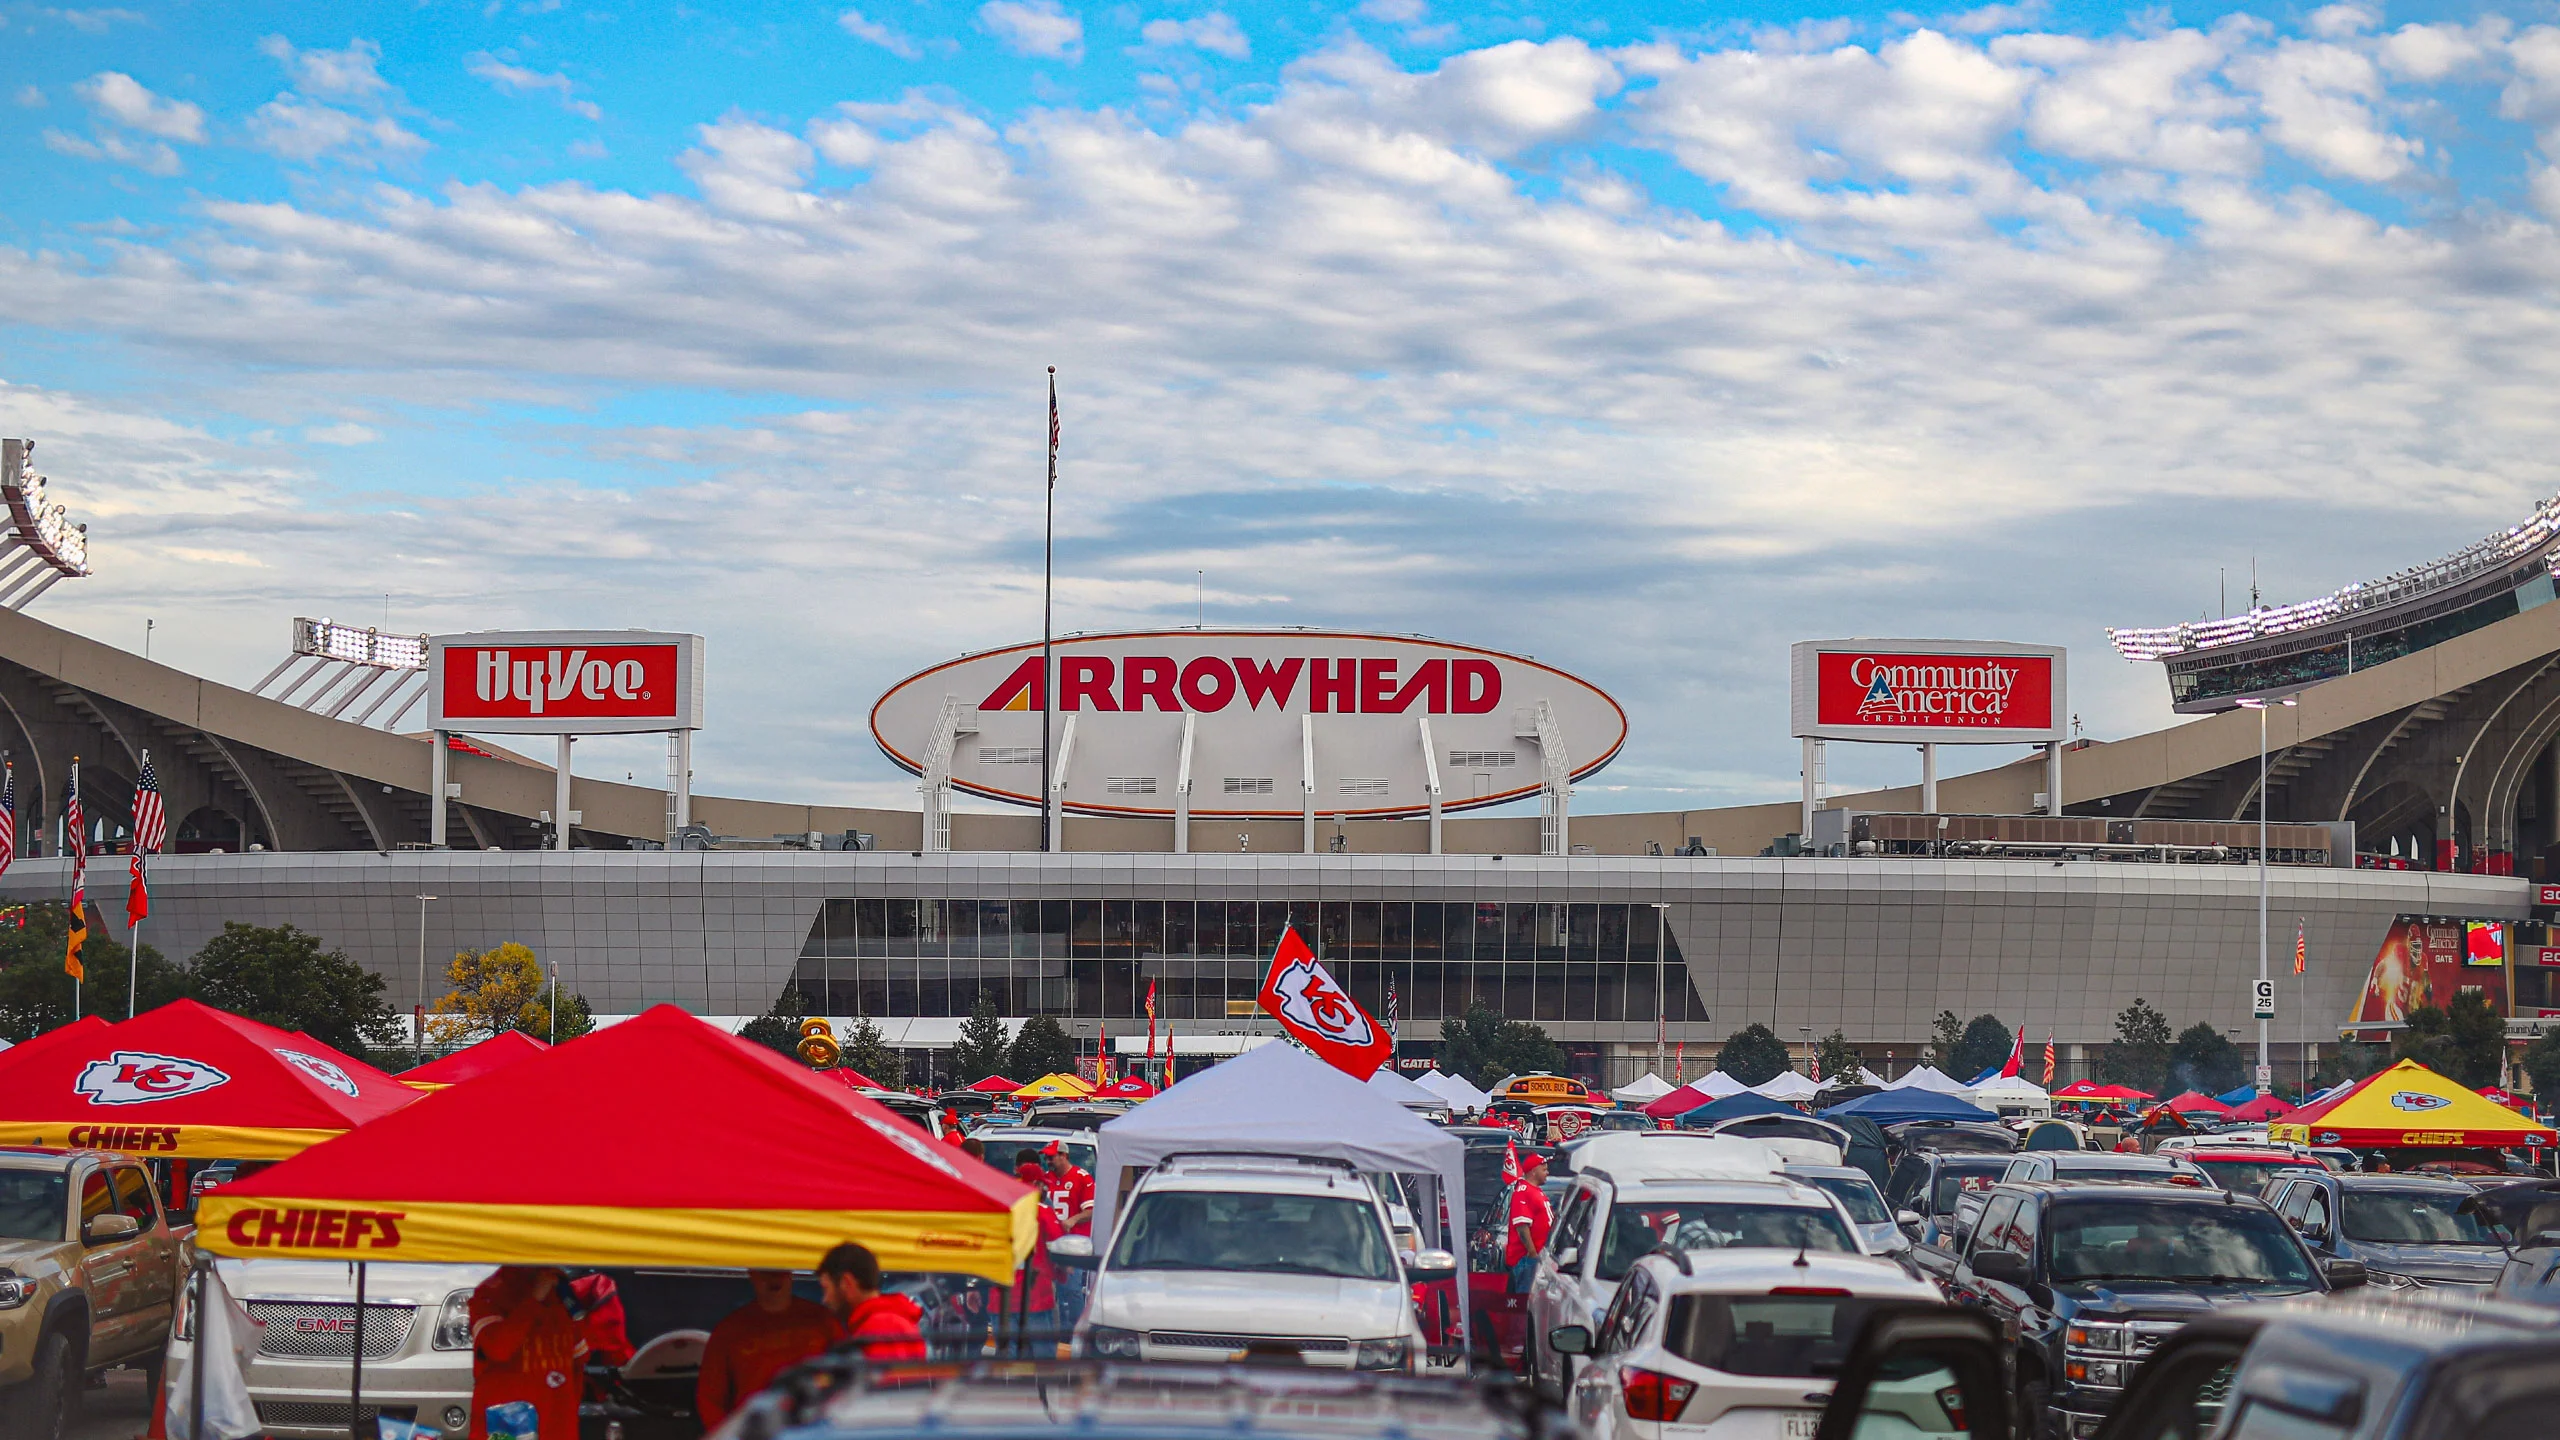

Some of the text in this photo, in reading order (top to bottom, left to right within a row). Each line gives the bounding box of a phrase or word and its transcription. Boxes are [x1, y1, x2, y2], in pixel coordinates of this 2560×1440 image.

[978, 656, 1502, 714] ARROWHEAD
[1851, 657, 2019, 700] Community
[1856, 671, 2004, 716] America
[1863, 714, 2001, 724] CREDIT UNION
[2435, 954, 2453, 963] GATE
[2257, 982, 2272, 997] G
[2257, 998, 2272, 1008] 25
[1400, 1059, 1431, 1069] GATE
[1531, 1082, 1565, 1092] SCHOOL BUS
[68, 1125, 181, 1151] CHIEFS
[2401, 1131, 2465, 1145] CHIEFS
[1965, 1176, 1980, 1191] 25
[226, 1208, 406, 1249] CHIEFS
[296, 1317, 357, 1333] GMC
